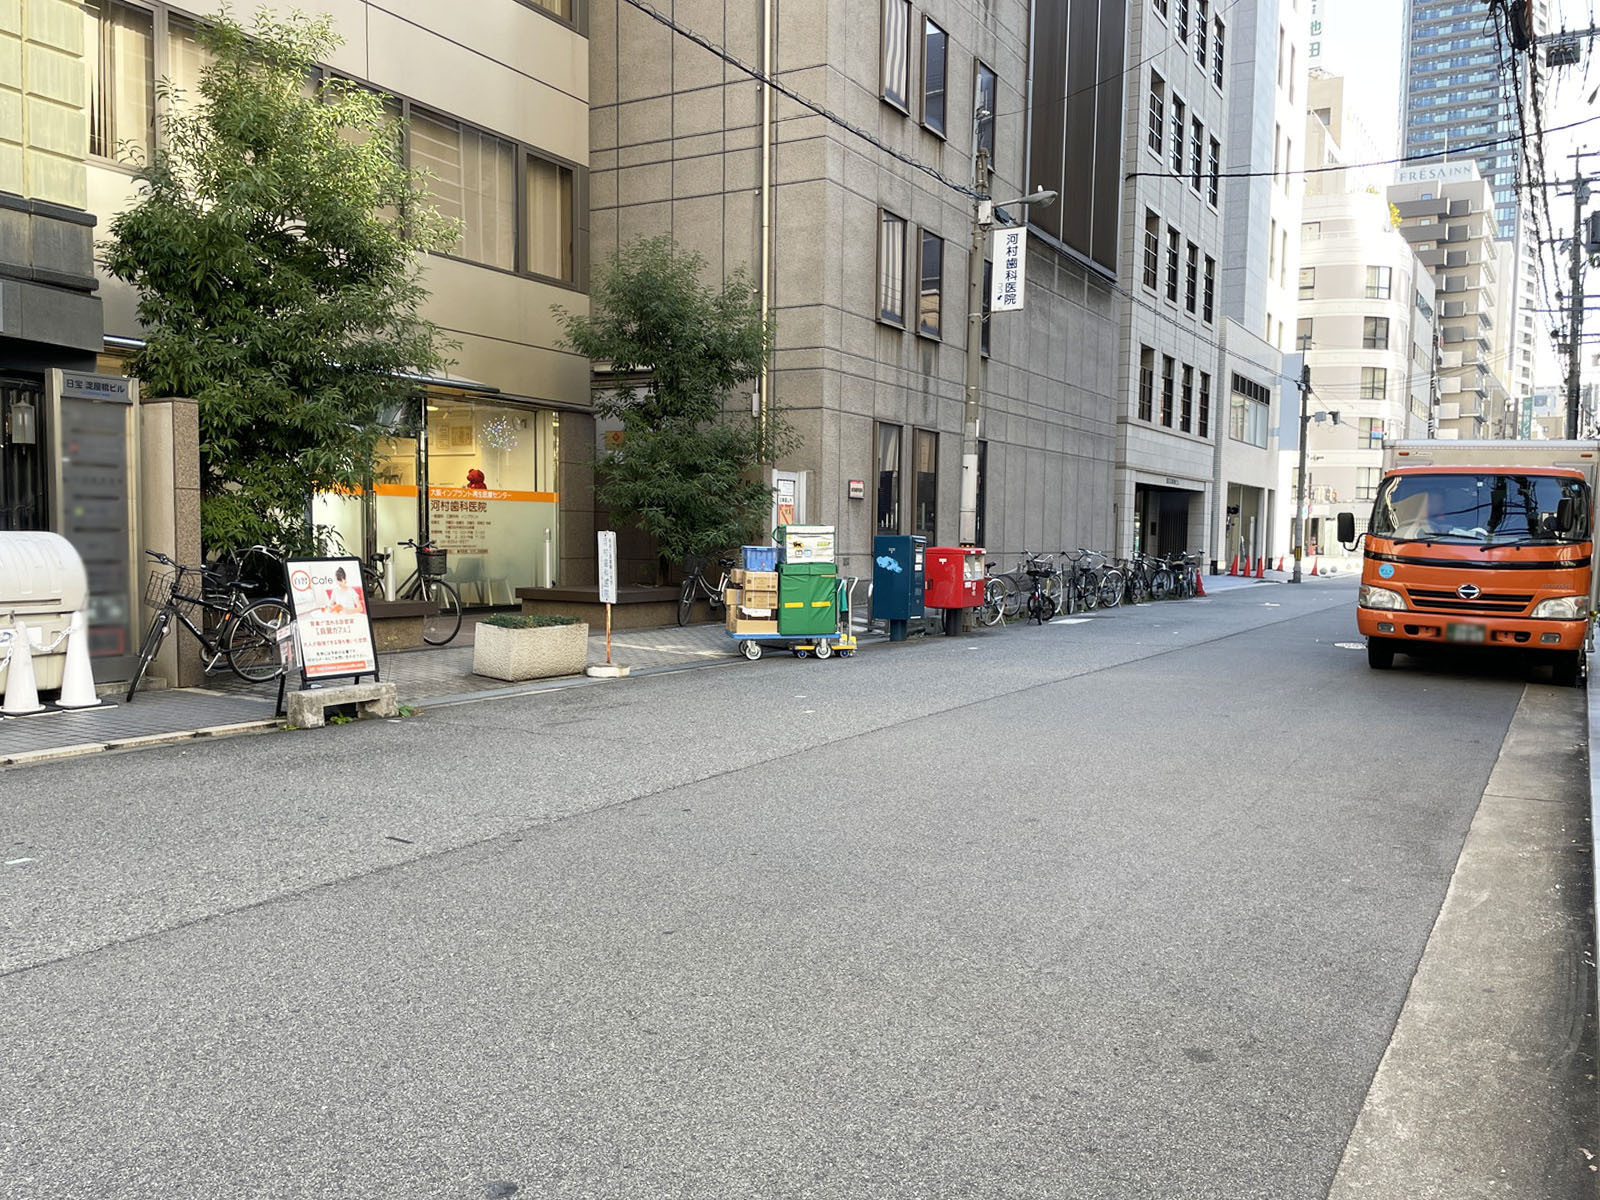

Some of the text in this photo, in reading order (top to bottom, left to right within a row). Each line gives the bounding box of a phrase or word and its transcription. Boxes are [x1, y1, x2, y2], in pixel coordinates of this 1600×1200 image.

[1449, 166, 1472, 176] INN
[1003, 233, 1019, 305] 河村歯科医院
[430, 499, 488, 513] 河村歯科医院
[311, 576, 334, 585] Cafe
